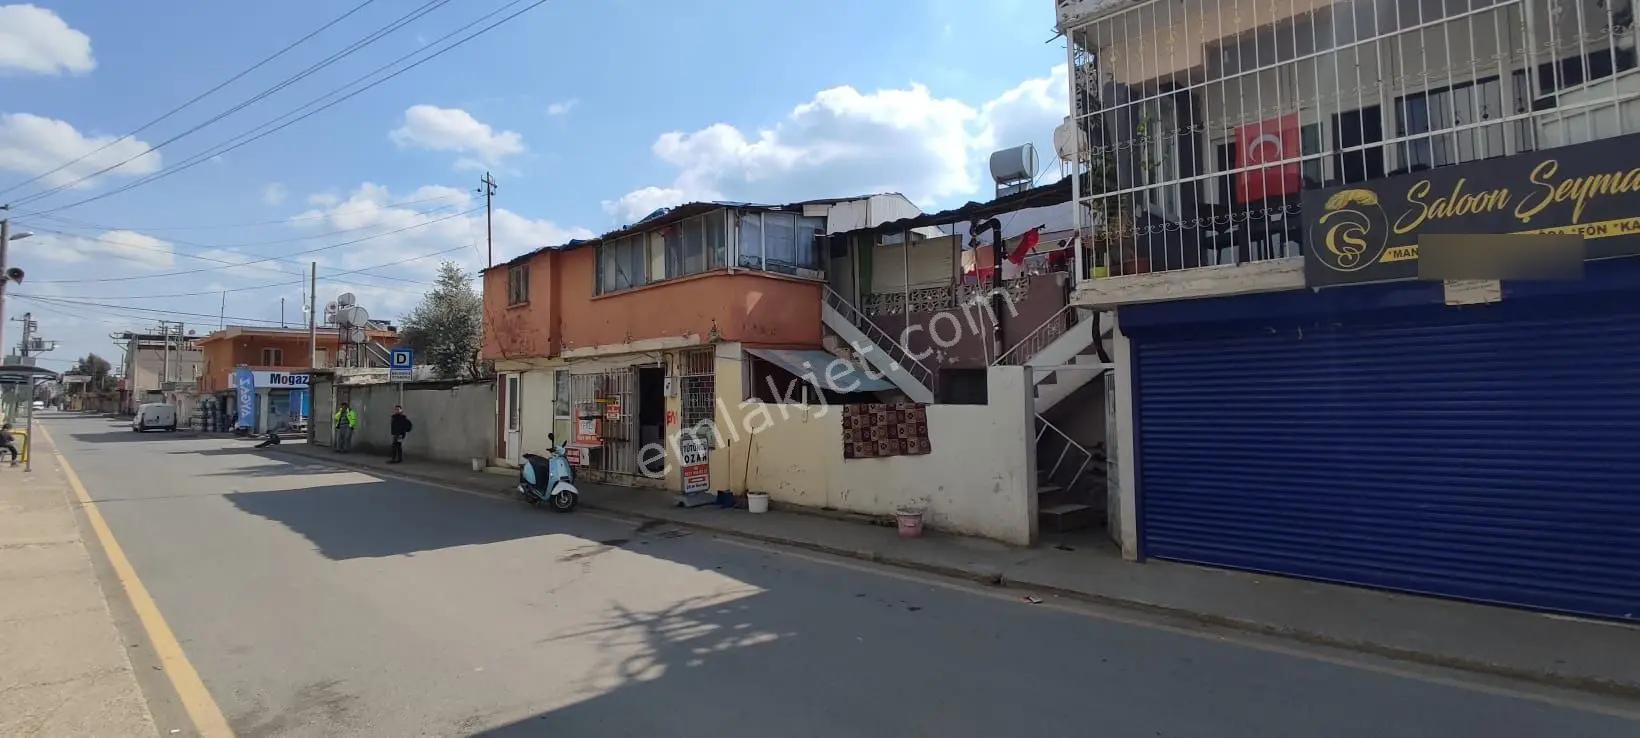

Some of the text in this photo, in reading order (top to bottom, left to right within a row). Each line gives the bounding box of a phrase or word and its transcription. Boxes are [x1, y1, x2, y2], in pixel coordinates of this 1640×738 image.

[1394, 179, 1513, 234] Saloon
[1392, 247, 1419, 260] MAN
[396, 353, 407, 364] D
[270, 373, 309, 386] Mogaz
[683, 442, 708, 453] TÜTÜÜ
